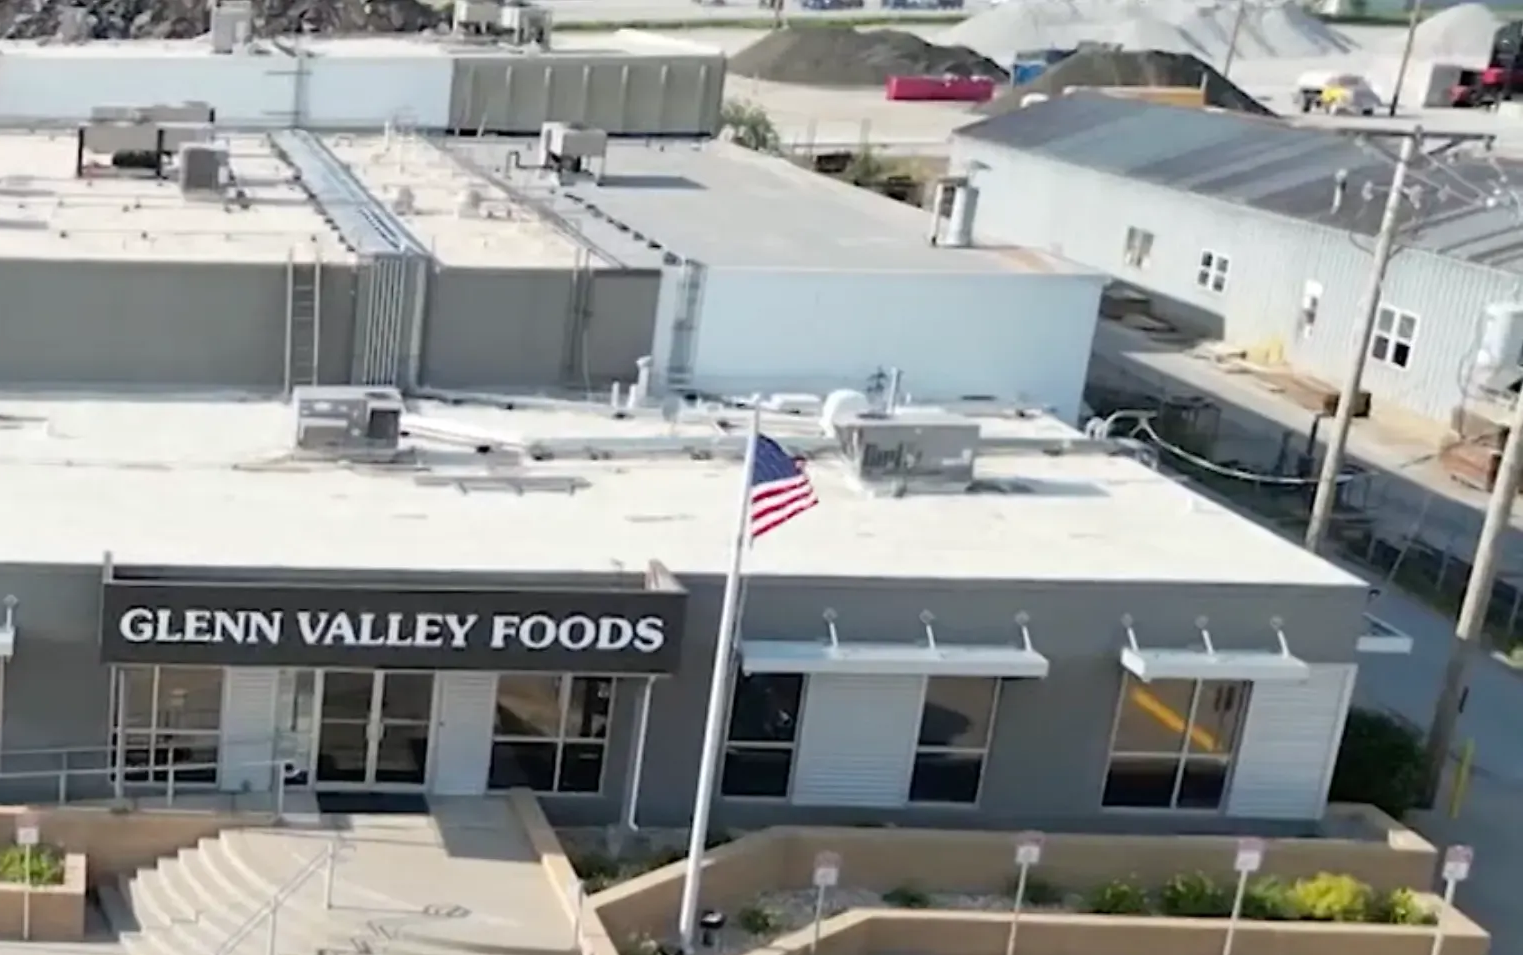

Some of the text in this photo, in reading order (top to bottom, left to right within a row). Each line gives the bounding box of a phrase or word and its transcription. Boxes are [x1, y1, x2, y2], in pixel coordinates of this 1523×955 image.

[119, 607, 665, 653] GLENN VALLEY FOODS
